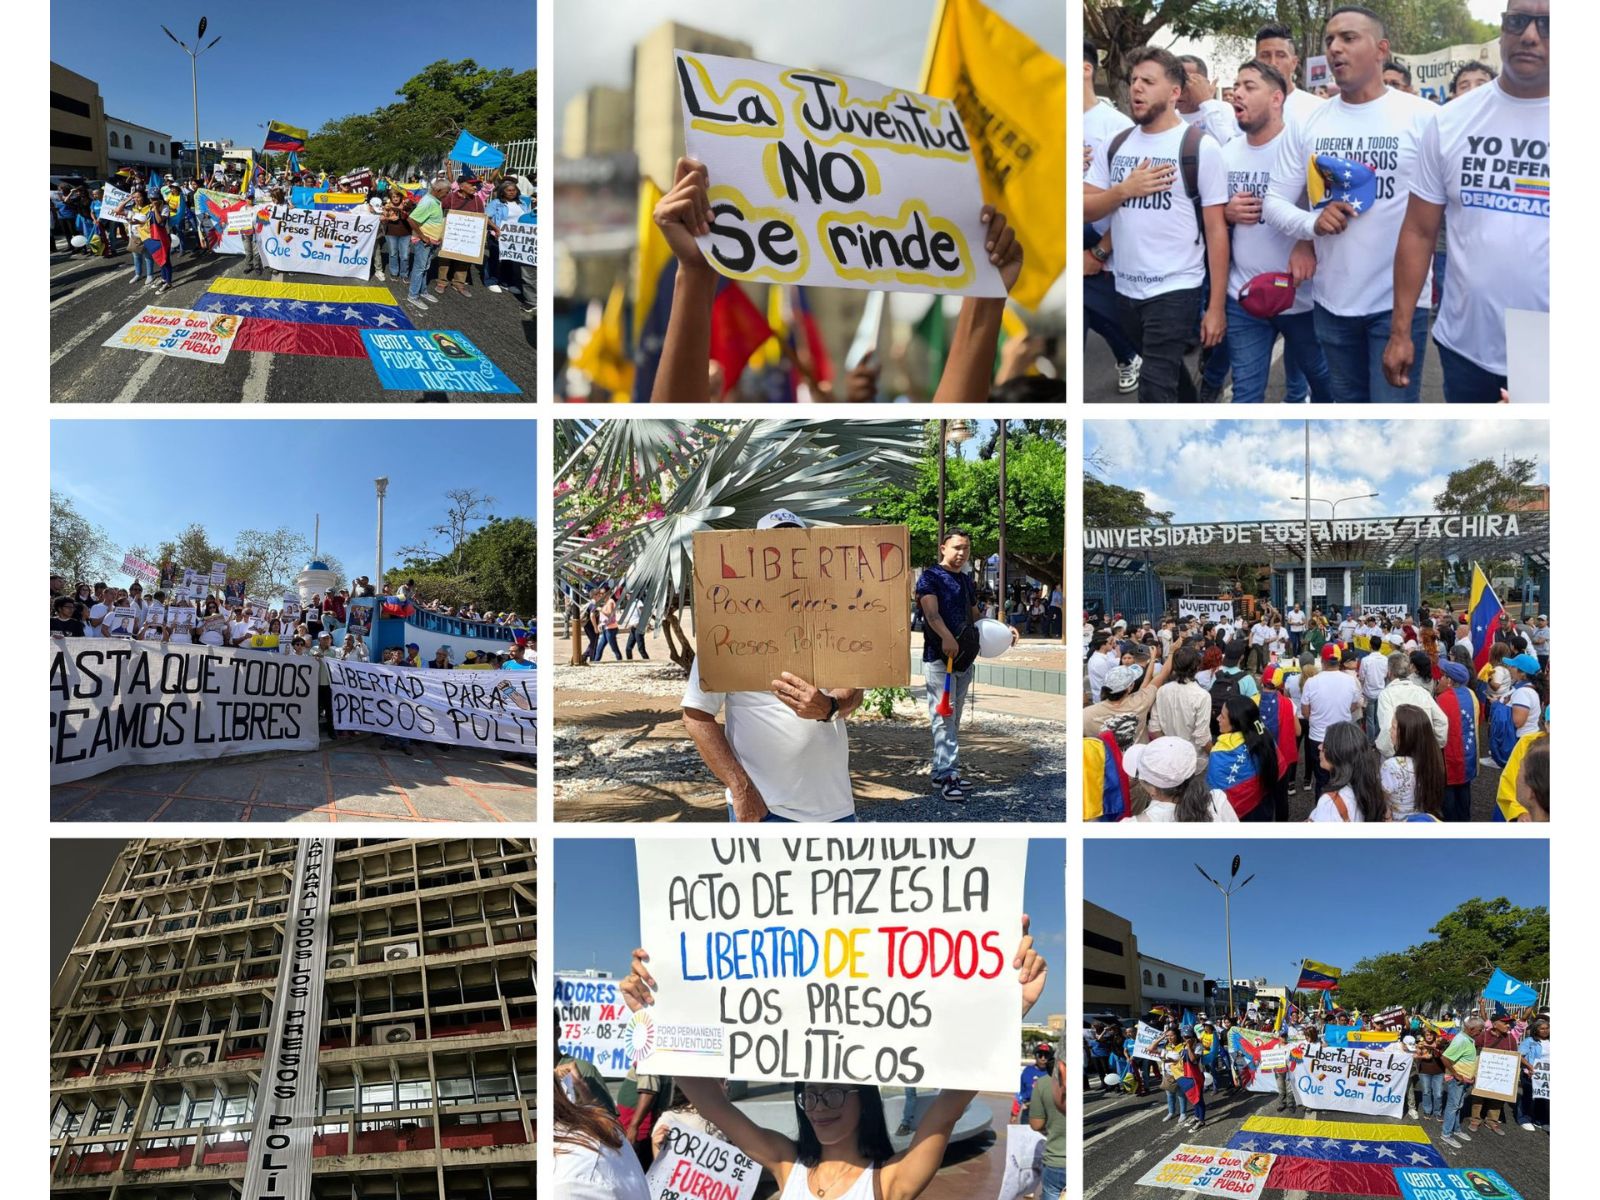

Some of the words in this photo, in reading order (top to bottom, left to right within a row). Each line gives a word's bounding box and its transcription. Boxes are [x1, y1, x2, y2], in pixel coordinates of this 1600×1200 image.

[677, 57, 777, 126] La
[790, 73, 970, 153] Juventud
[1315, 137, 1353, 151] LIBEREN
[1356, 137, 1363, 151] A
[1368, 136, 1400, 150] TODOS
[1467, 135, 1503, 156] YO
[1510, 137, 1550, 160] VO
[777, 139, 866, 204] NO
[1460, 172, 1484, 188] DE
[1488, 174, 1511, 191] LA
[1462, 156, 1487, 172] EN
[1491, 158, 1550, 178] DEFEN
[277, 220, 309, 235] Presos
[323, 218, 349, 233] para
[353, 215, 374, 233] los
[709, 204, 798, 273] Se
[828, 211, 960, 271] rinde
[264, 236, 291, 257] Que
[300, 240, 331, 261] Sean
[335, 243, 368, 265] Todos
[500, 234, 537, 246] SALIM
[508, 243, 516, 251] A
[1083, 526, 1214, 549] UNIVERSIDAD
[1222, 523, 1251, 544] DE
[1261, 521, 1305, 543] LOS
[1317, 520, 1396, 542] ANDES
[1411, 513, 1520, 539] TACHIRA
[720, 542, 905, 582] LIBERTAD
[706, 584, 772, 615] Para
[1180, 600, 1230, 612] JUVENTUD
[706, 624, 780, 657] Presos
[50, 649, 152, 700] ASTA
[160, 652, 223, 695] QUE
[229, 658, 312, 698] TODOS
[442, 681, 508, 712] PARA
[194, 701, 301, 743] LIBRES
[334, 692, 435, 734] PRESOS
[308, 838, 323, 858] AD
[302, 864, 321, 900] PARA
[668, 872, 740, 921] ACTO
[752, 869, 794, 919] DE
[811, 867, 882, 915] PAZ
[889, 865, 933, 914] ES
[942, 865, 989, 913] LA
[295, 907, 317, 960] TODOS
[680, 926, 820, 981] LIBERTAD
[823, 926, 871, 979] DE
[877, 926, 1005, 980] TODOS
[289, 963, 312, 998] LOS
[554, 981, 616, 1003] ADORES
[599, 1004, 625, 1021] YA!
[719, 986, 783, 1025] LOS
[806, 982, 933, 1029] PRESOS
[273, 1010, 306, 1099] PRESOS
[1310, 1059, 1343, 1074] Presos
[1356, 1056, 1382, 1070] para
[1387, 1053, 1407, 1072] los
[1298, 1075, 1324, 1095] Que
[1334, 1079, 1364, 1100] Sean
[1368, 1081, 1402, 1104] Todos
[1534, 1072, 1550, 1081] SA
[1541, 1081, 1549, 1089] A
[258, 1115, 293, 1200] POLÍ
[665, 1127, 702, 1158] POR
[696, 1141, 729, 1172] LOS
[734, 1153, 754, 1170] QUE
[669, 1159, 740, 1200] FUERON
[731, 1168, 747, 1182] SE
